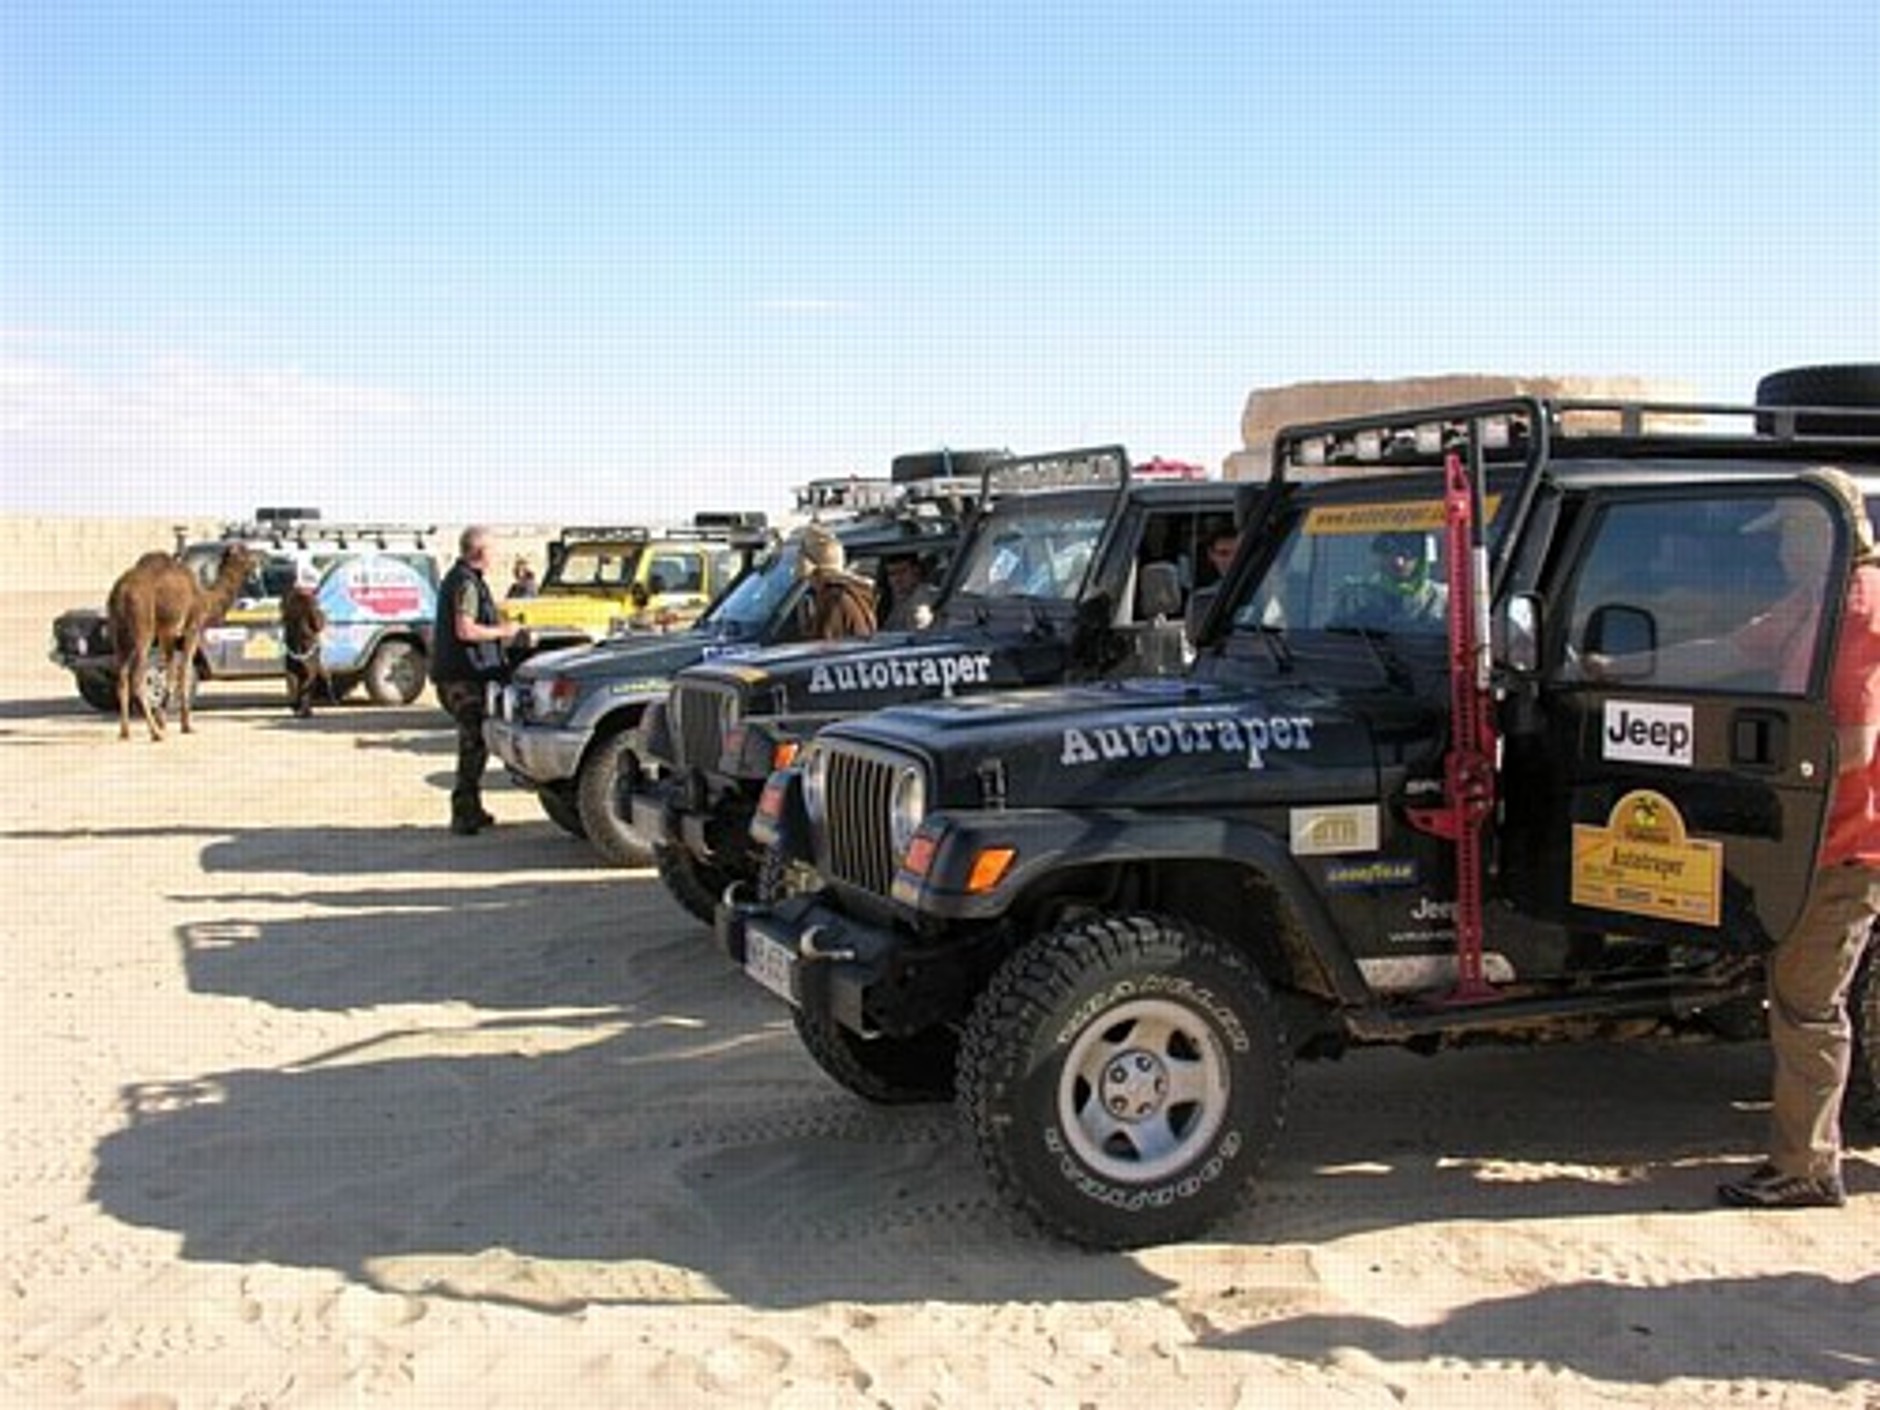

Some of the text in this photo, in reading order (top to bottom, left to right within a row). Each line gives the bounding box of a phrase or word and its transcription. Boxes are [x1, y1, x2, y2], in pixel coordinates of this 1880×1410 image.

[808, 653, 991, 697] Autotraper
[1060, 716, 1313, 768] Autotraper
[1609, 710, 1689, 755] Jeep
